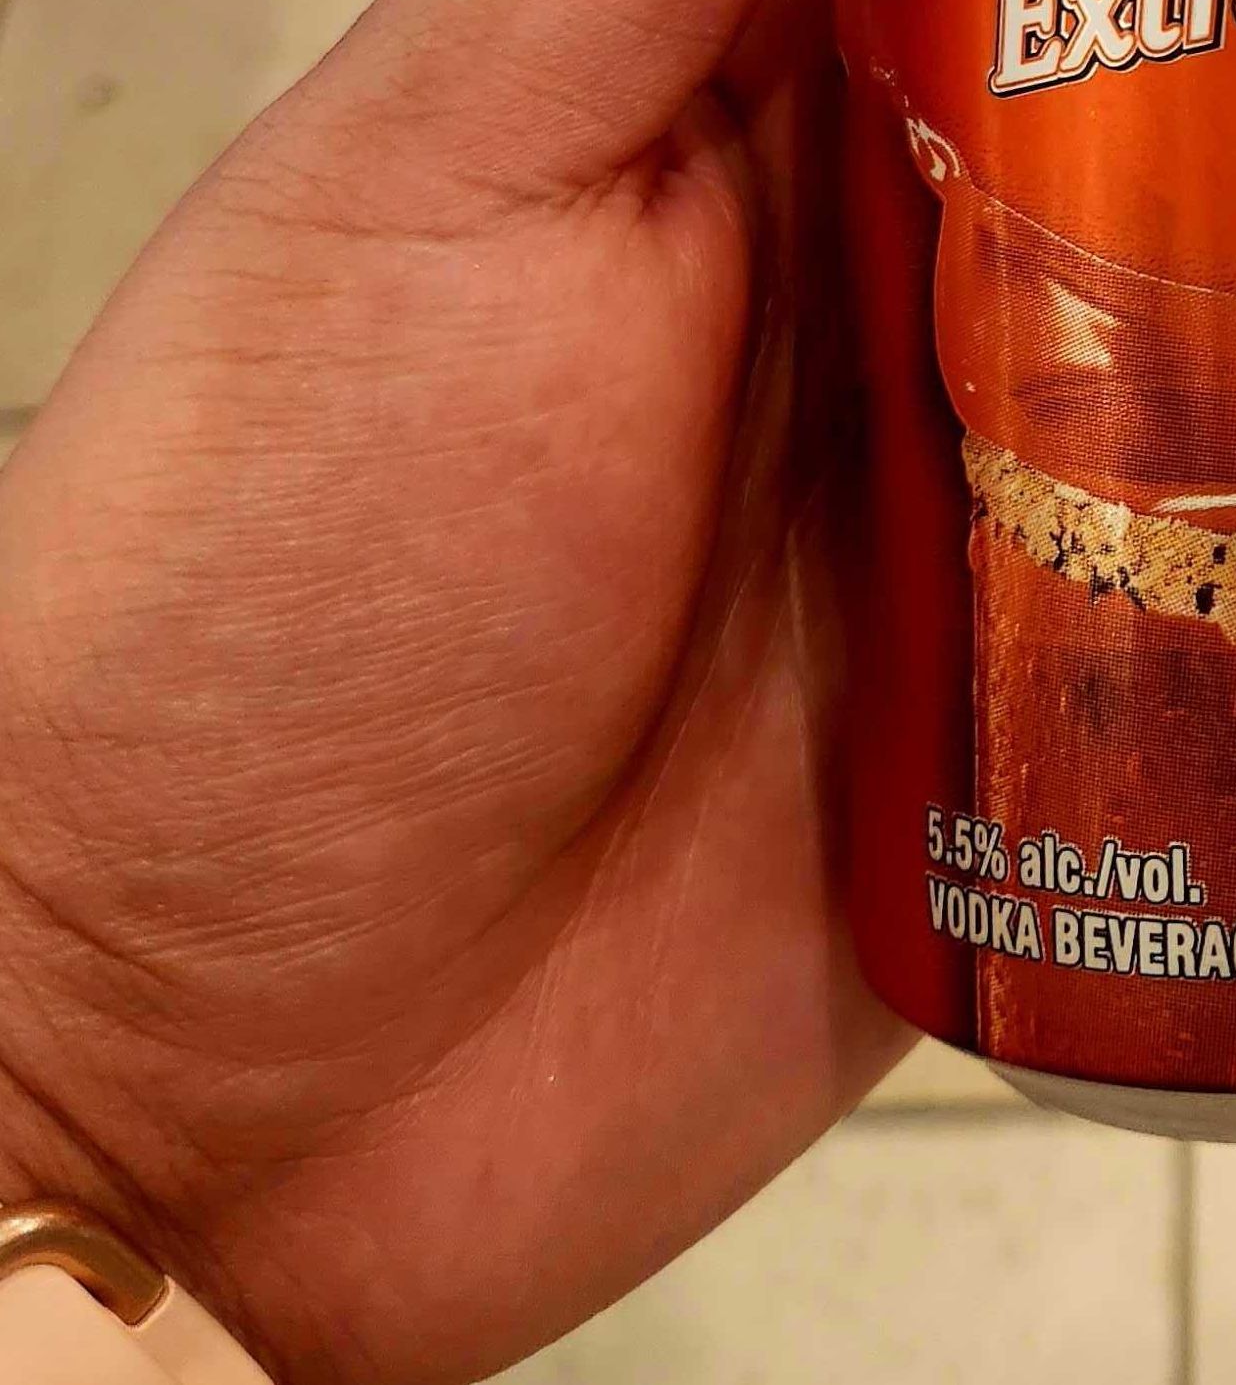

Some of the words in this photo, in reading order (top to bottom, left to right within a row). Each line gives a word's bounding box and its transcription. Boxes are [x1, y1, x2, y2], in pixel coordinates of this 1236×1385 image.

[927, 806, 1009, 880] 5.5%
[1018, 830, 1207, 904] alc./vol.
[928, 876, 1042, 960] VODKA
